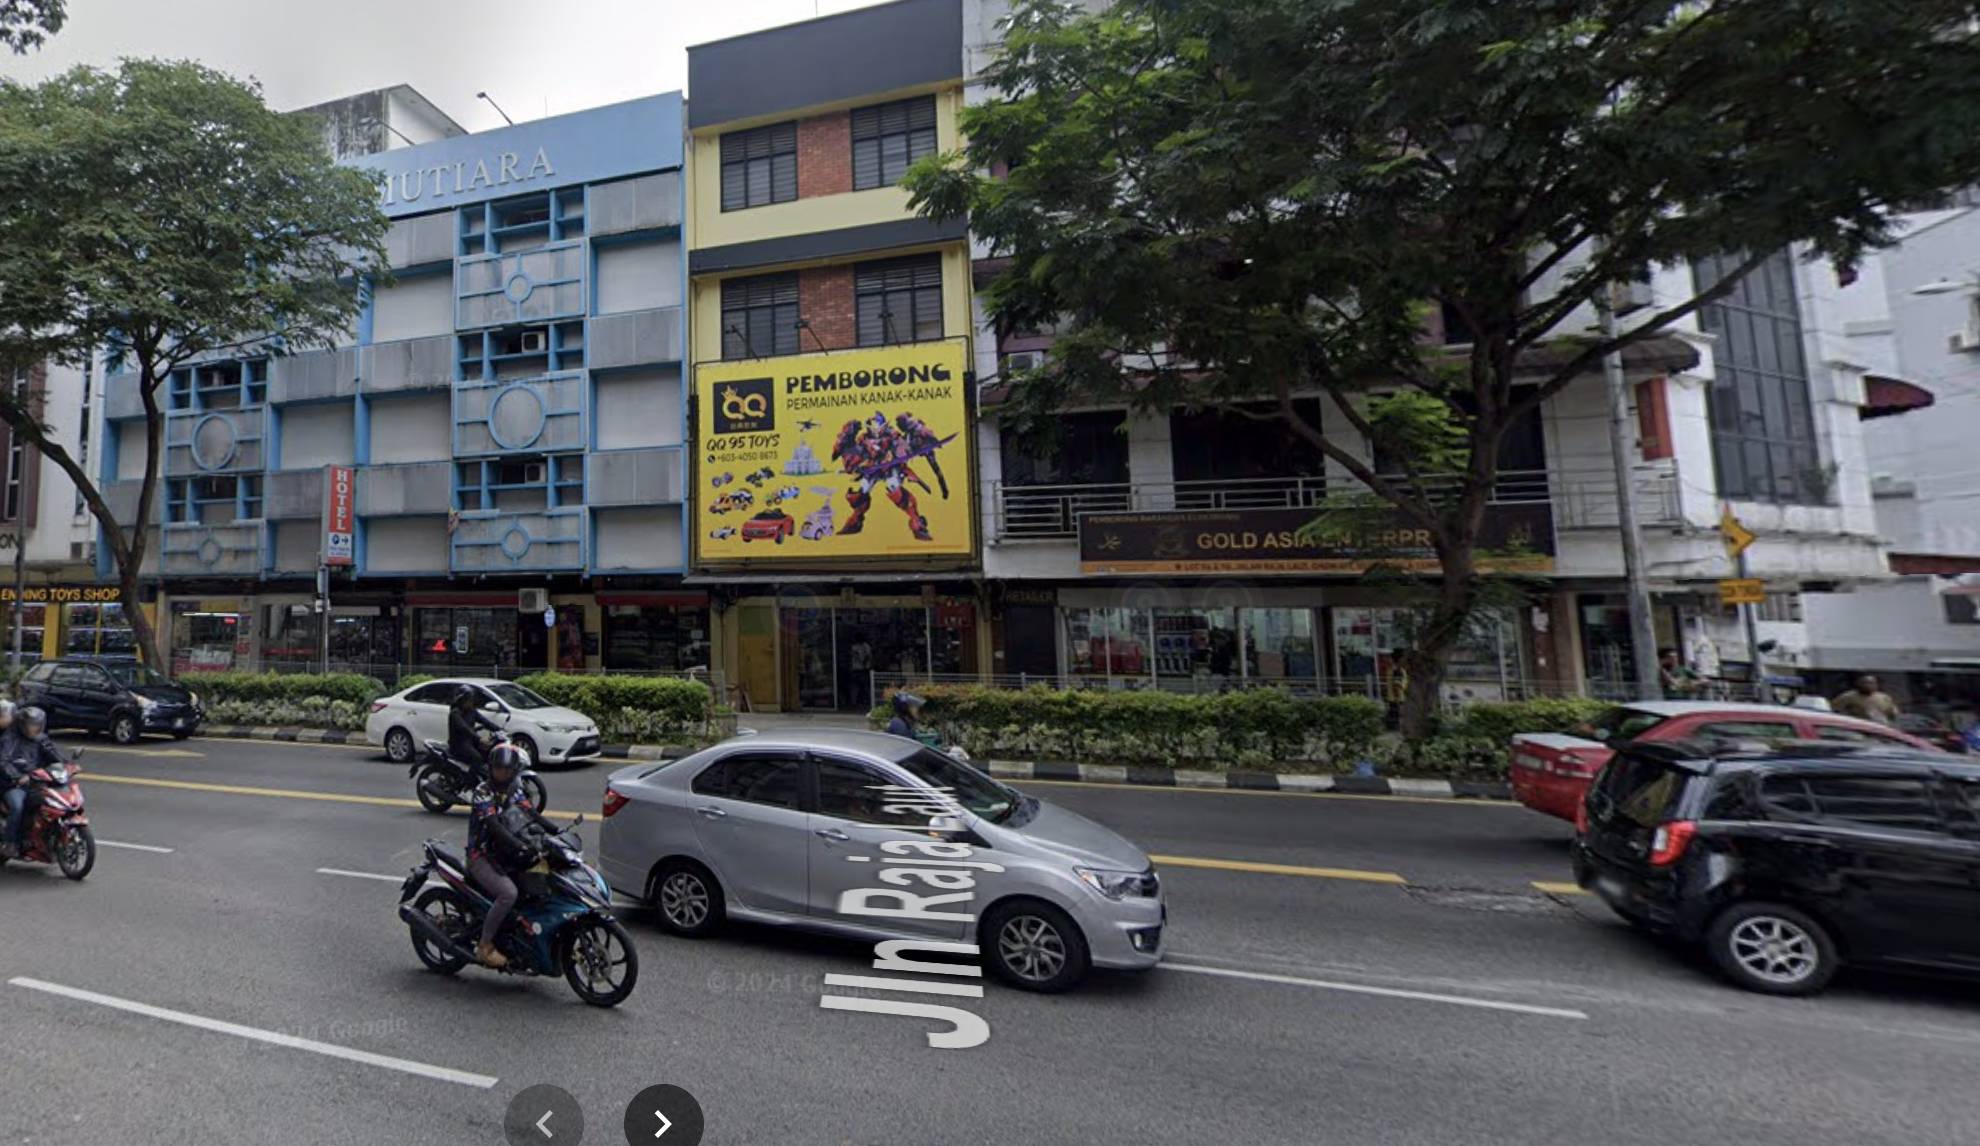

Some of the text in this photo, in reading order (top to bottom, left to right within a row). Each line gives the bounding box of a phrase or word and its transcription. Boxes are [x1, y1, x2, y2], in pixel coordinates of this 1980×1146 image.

[786, 363, 951, 394] PEMBORONG
[786, 386, 952, 411] PERMAINAN KANAK-KANAK
[706, 433, 780, 452] QQ 95 TOYS
[336, 470, 349, 531] HOTEL
[1197, 532, 1257, 549] GOLD
[49, 588, 80, 600] TOYS
[83, 588, 120, 600] SHOP
